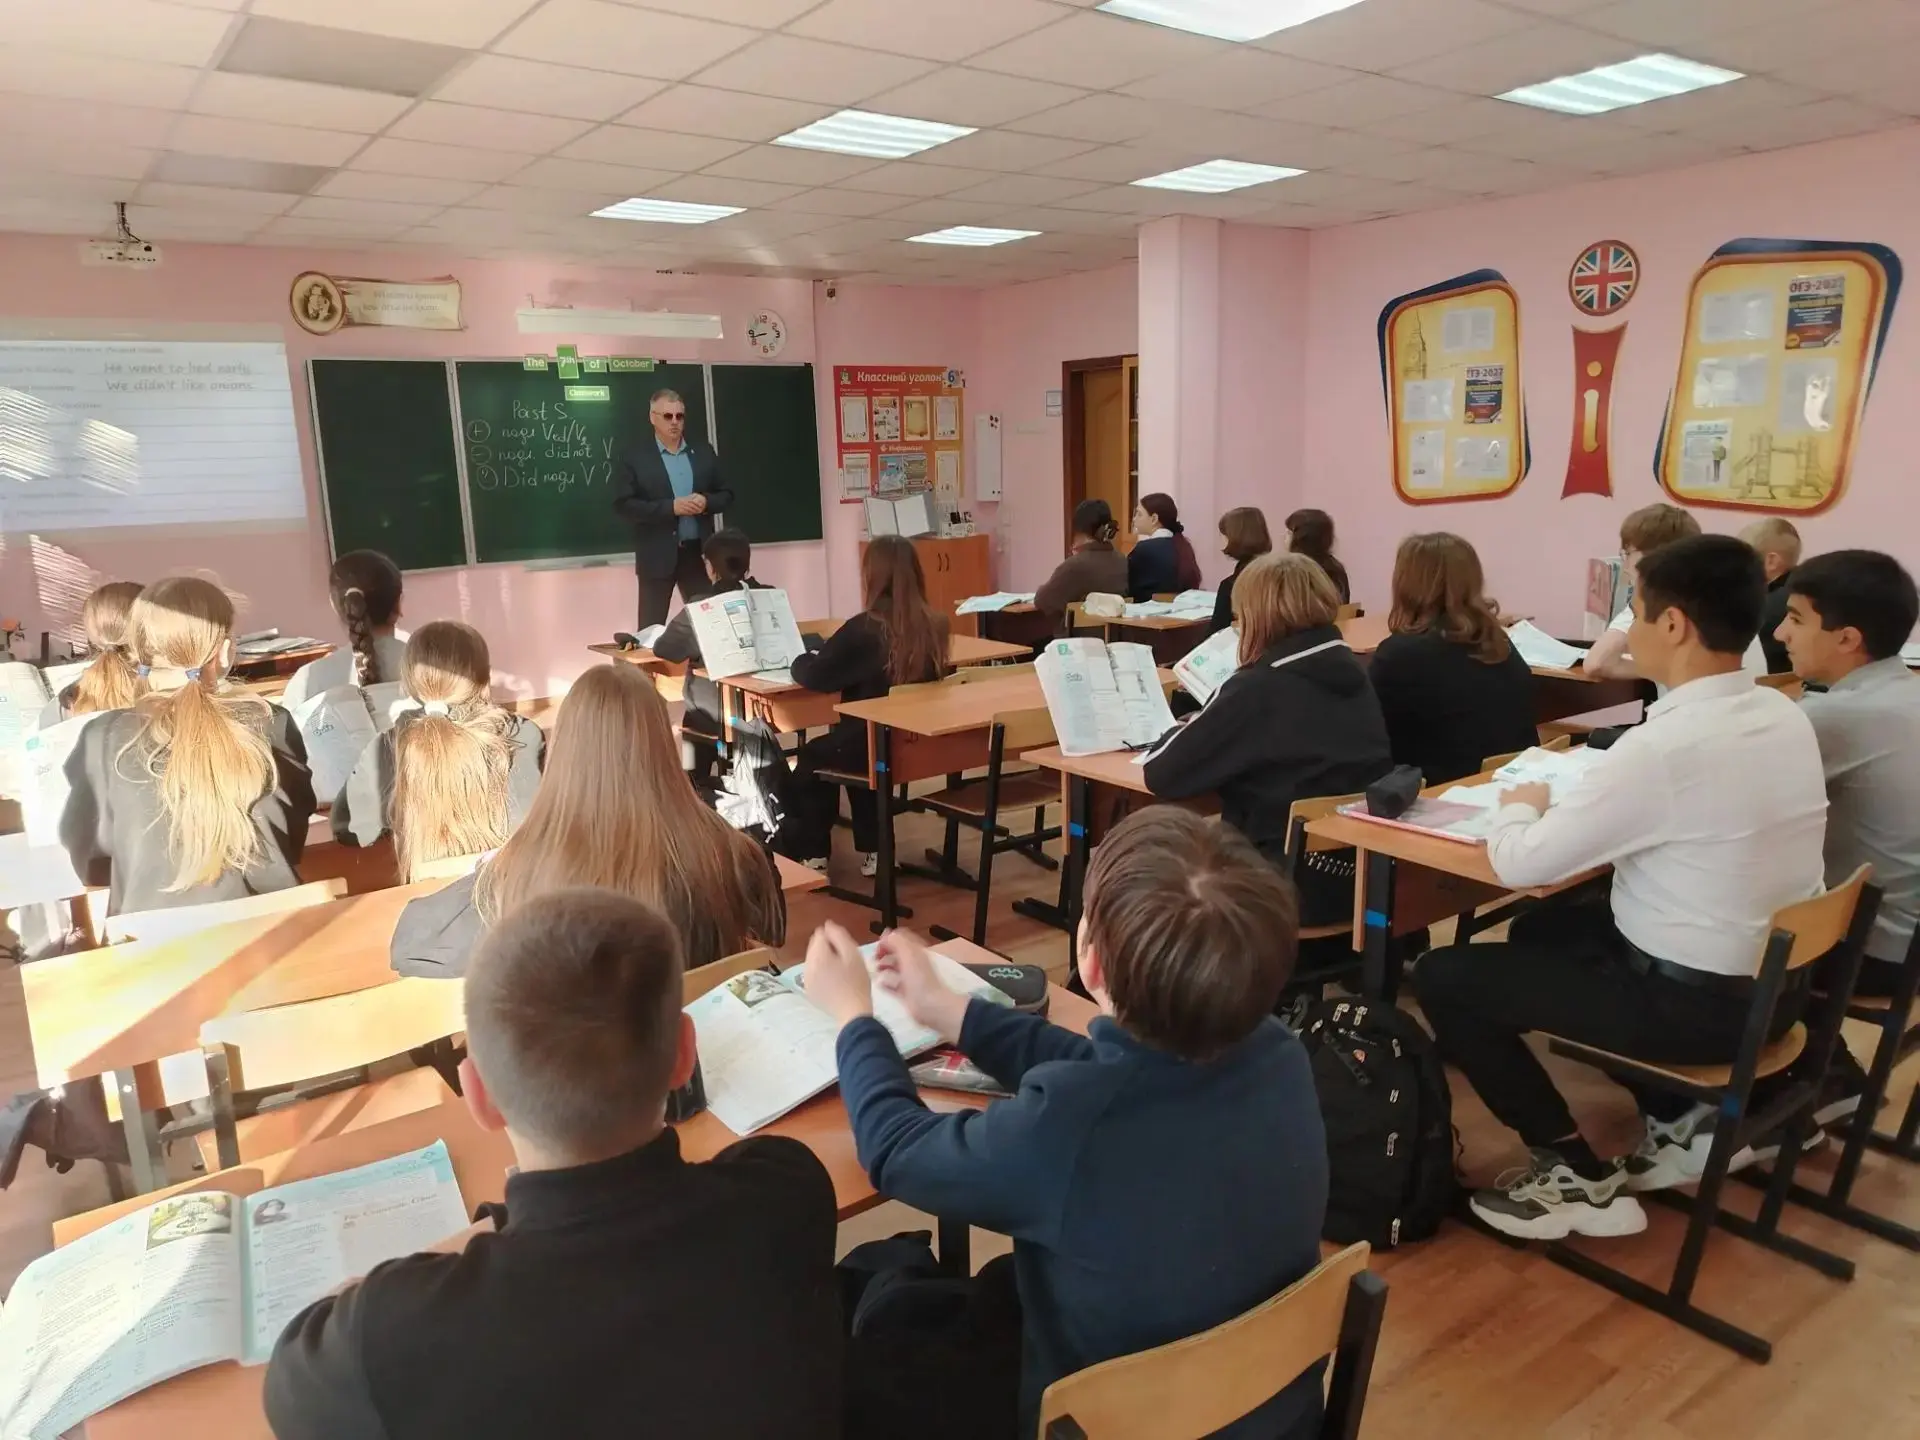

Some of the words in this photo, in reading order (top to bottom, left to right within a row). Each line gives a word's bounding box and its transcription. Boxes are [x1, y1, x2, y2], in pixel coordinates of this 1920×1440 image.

[128, 363, 164, 374] went
[526, 357, 545, 367] The
[589, 359, 600, 369] of
[612, 359, 650, 369] October
[857, 370, 906, 382] Классный
[105, 380, 129, 391] We
[182, 379, 204, 391] like
[513, 400, 547, 420] Past
[504, 466, 538, 488] Did
[580, 461, 596, 487] V
